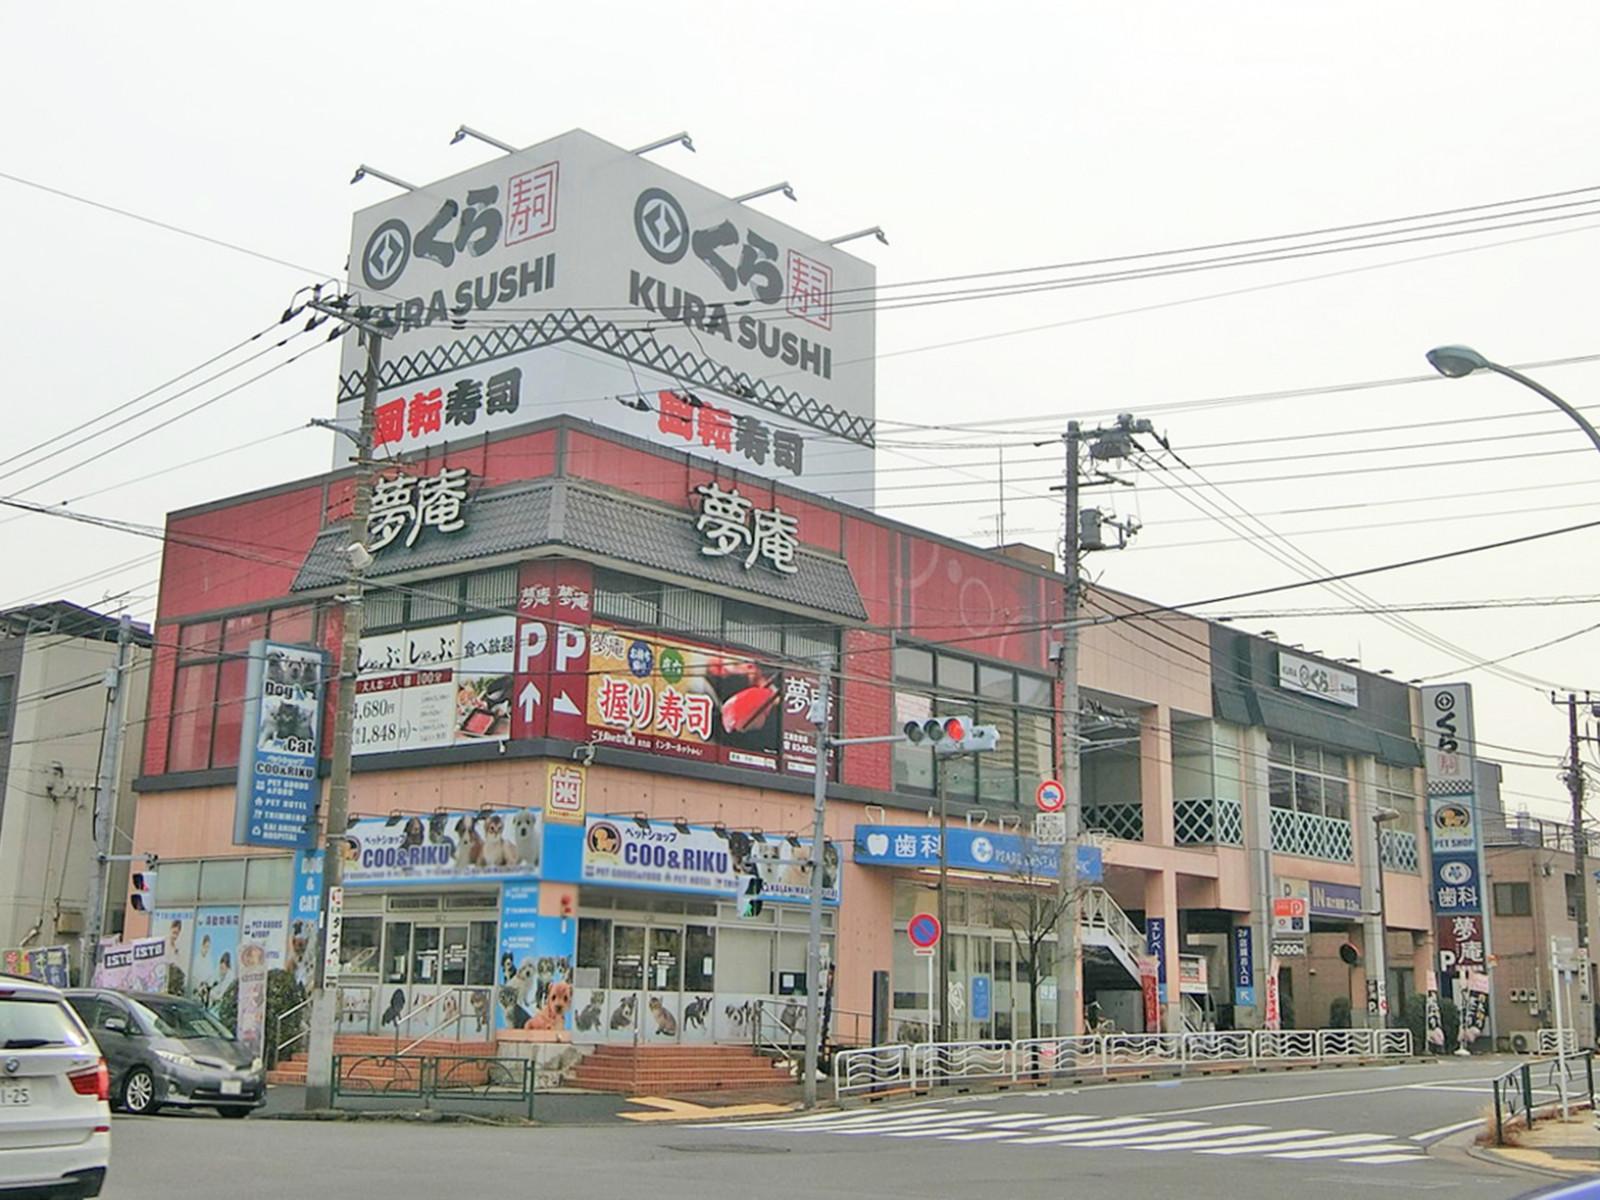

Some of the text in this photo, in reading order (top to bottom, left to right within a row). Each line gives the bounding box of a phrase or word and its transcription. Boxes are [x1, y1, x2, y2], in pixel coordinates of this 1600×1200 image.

[413, 185, 503, 268] くら
[454, 253, 556, 318] SUSHI
[692, 219, 784, 305] くら
[628, 270, 832, 381] KURA SUSHI
[657, 388, 804, 477] 回転寿司
[367, 467, 471, 552] 夢庵
[697, 482, 799, 573] 夢庵
[519, 622, 547, 673] P
[556, 623, 587, 673] P
[597, 677, 714, 741] 握り寿司
[363, 845, 451, 869] COO&RIKU
[624, 842, 728, 874] COO&RIKU
[894, 833, 944, 859] 歯科
[1438, 886, 1478, 908] 歯科
[1440, 950, 1456, 972] P
